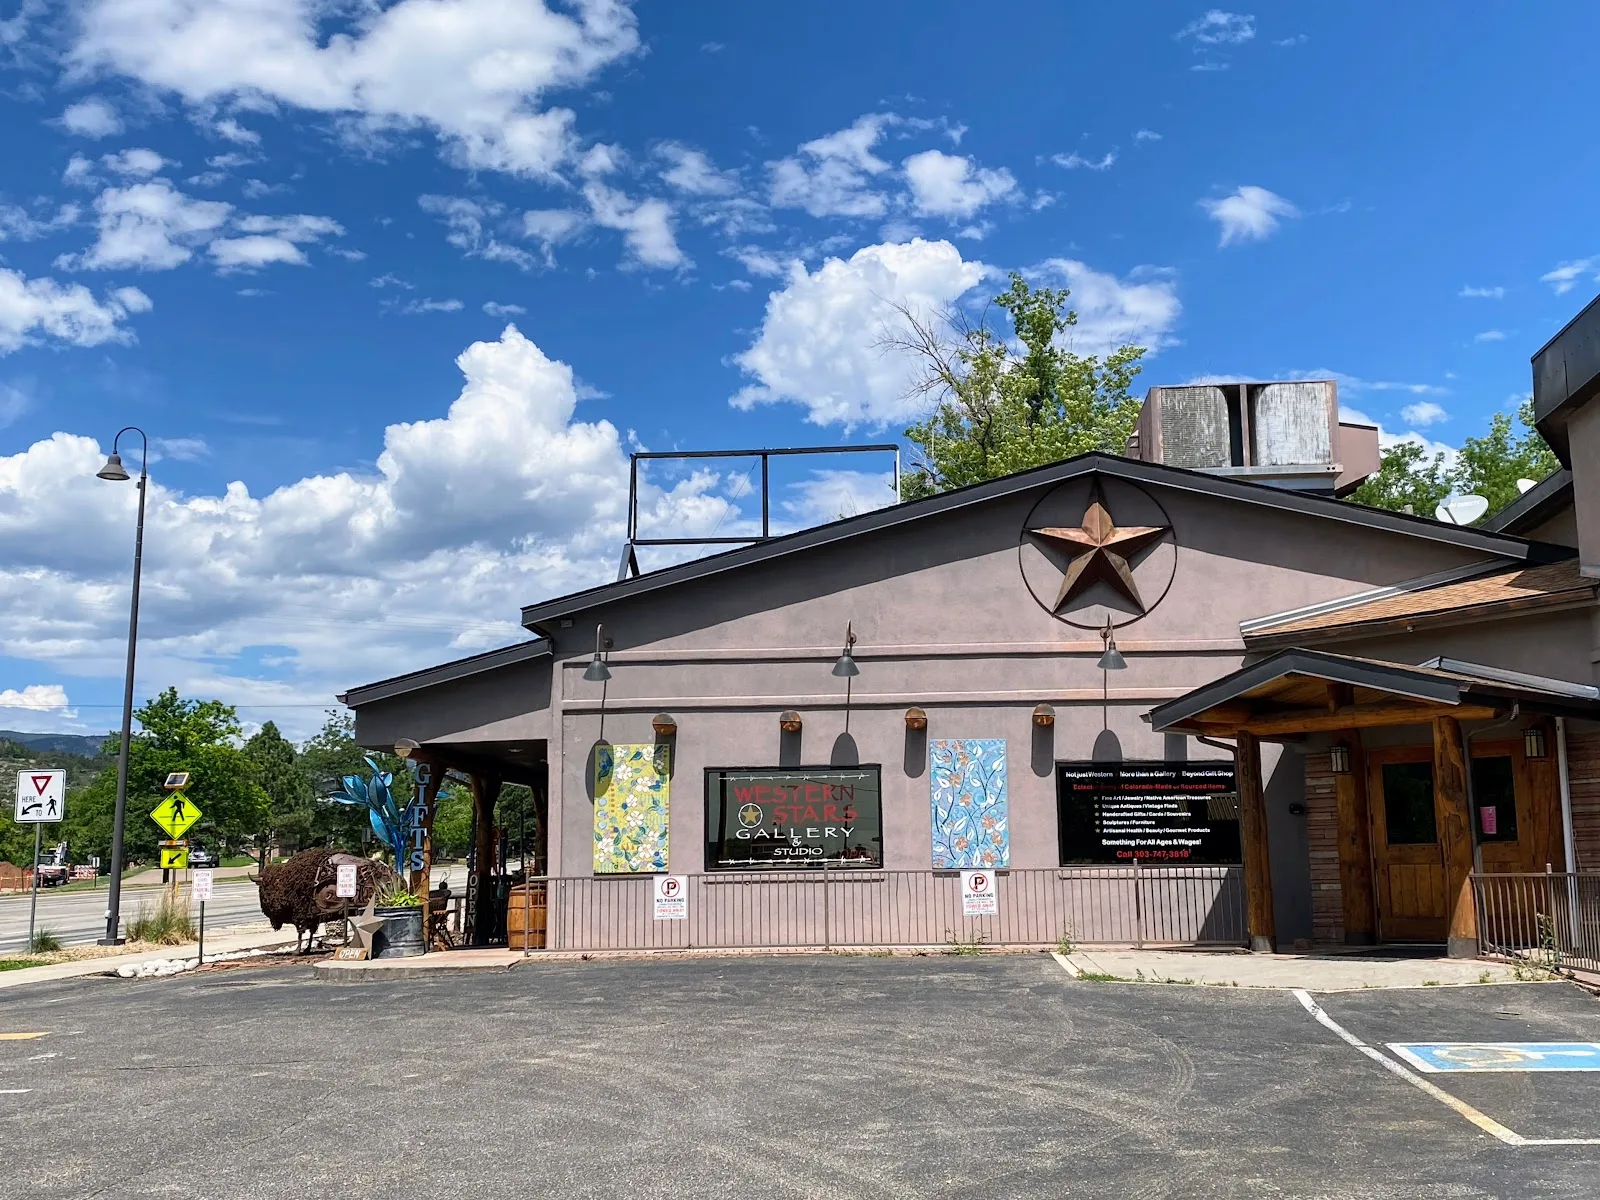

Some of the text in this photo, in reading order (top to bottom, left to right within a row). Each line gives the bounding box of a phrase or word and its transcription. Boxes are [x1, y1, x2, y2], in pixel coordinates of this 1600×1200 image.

[733, 783, 854, 803] WESTERN
[410, 763, 431, 871] GIFTS
[771, 804, 858, 824] STARS
[735, 827, 855, 839] GALLERY
[791, 838, 802, 847] &
[774, 848, 823, 856] STUDIO
[466, 874, 478, 927] OPEN
[339, 949, 361, 959] OPEN
